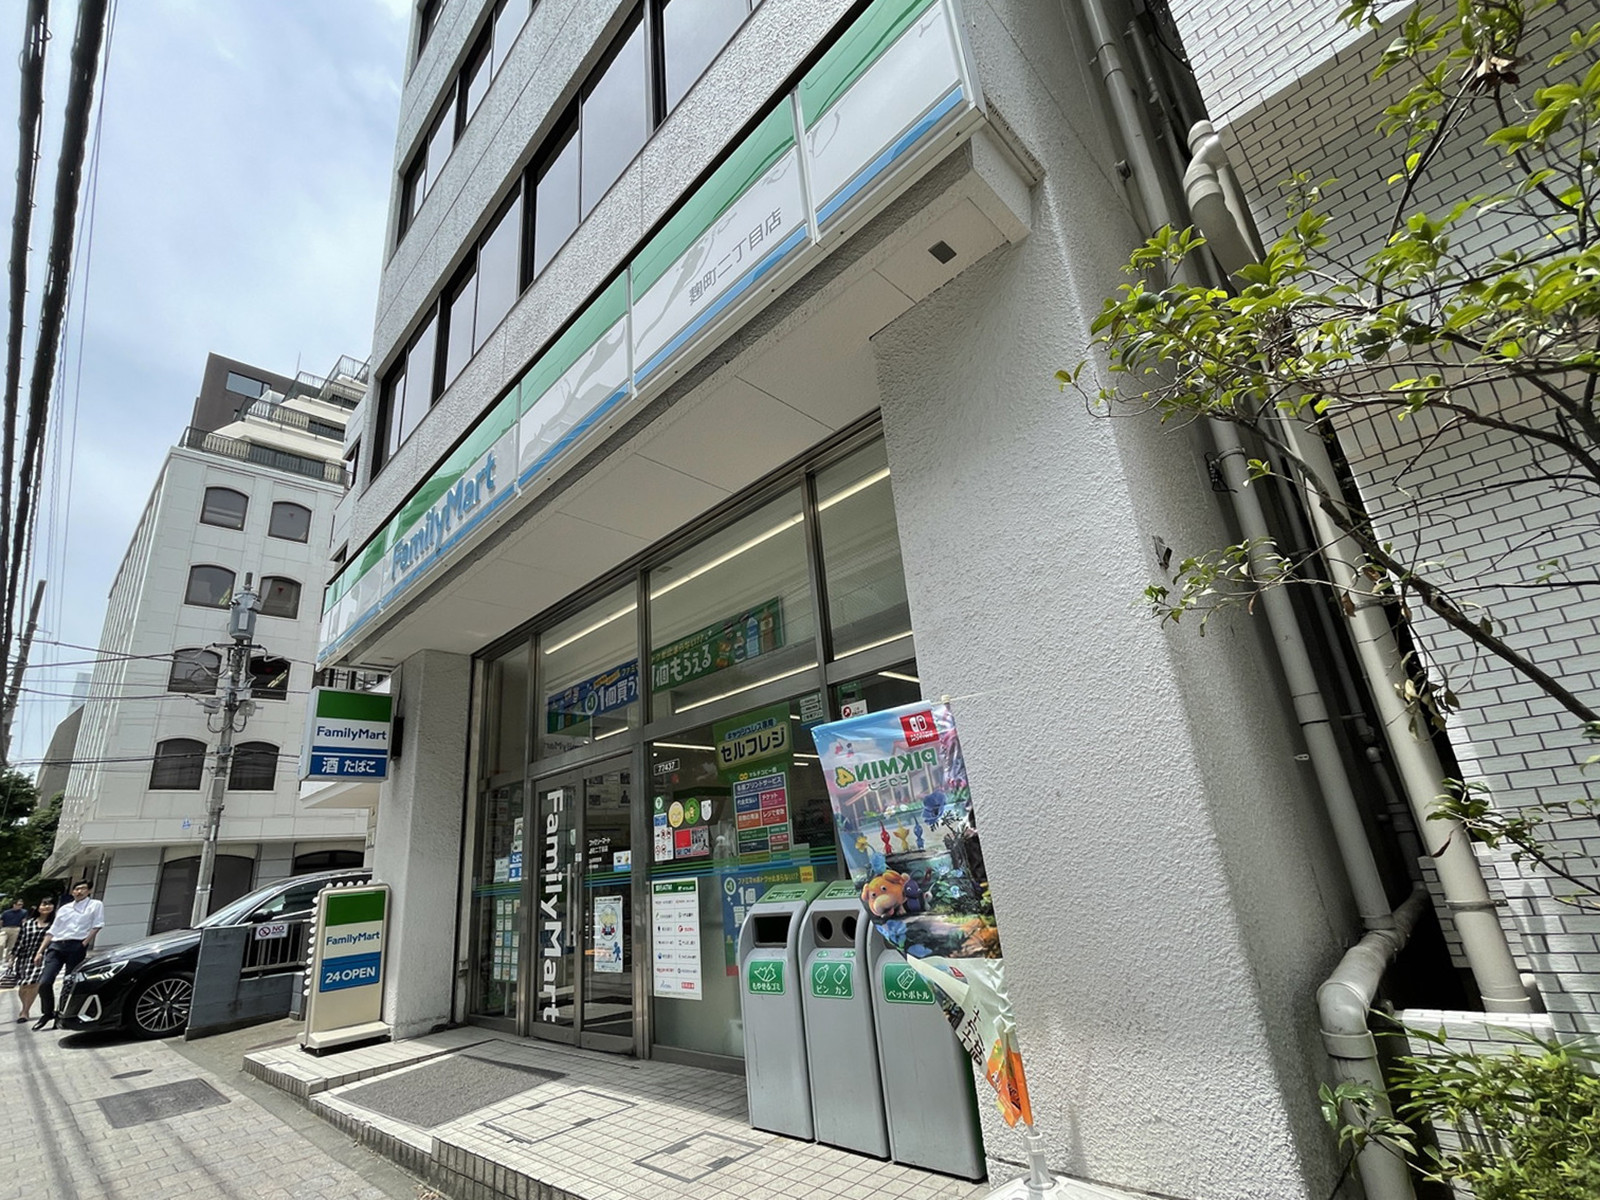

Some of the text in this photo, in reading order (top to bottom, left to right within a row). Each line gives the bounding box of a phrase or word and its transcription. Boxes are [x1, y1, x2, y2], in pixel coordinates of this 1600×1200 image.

[391, 450, 495, 581] FamilyMart
[316, 726, 387, 741] FamilyMart
[721, 727, 785, 762] セルフレジ
[322, 757, 376, 773] 酒 たばこ
[540, 789, 563, 1022] FamilyMart
[326, 931, 380, 946] FamilyMart
[325, 966, 376, 984] 24 OPEN
[835, 986, 849, 995] カン
[888, 990, 930, 1000] ペットボトル
